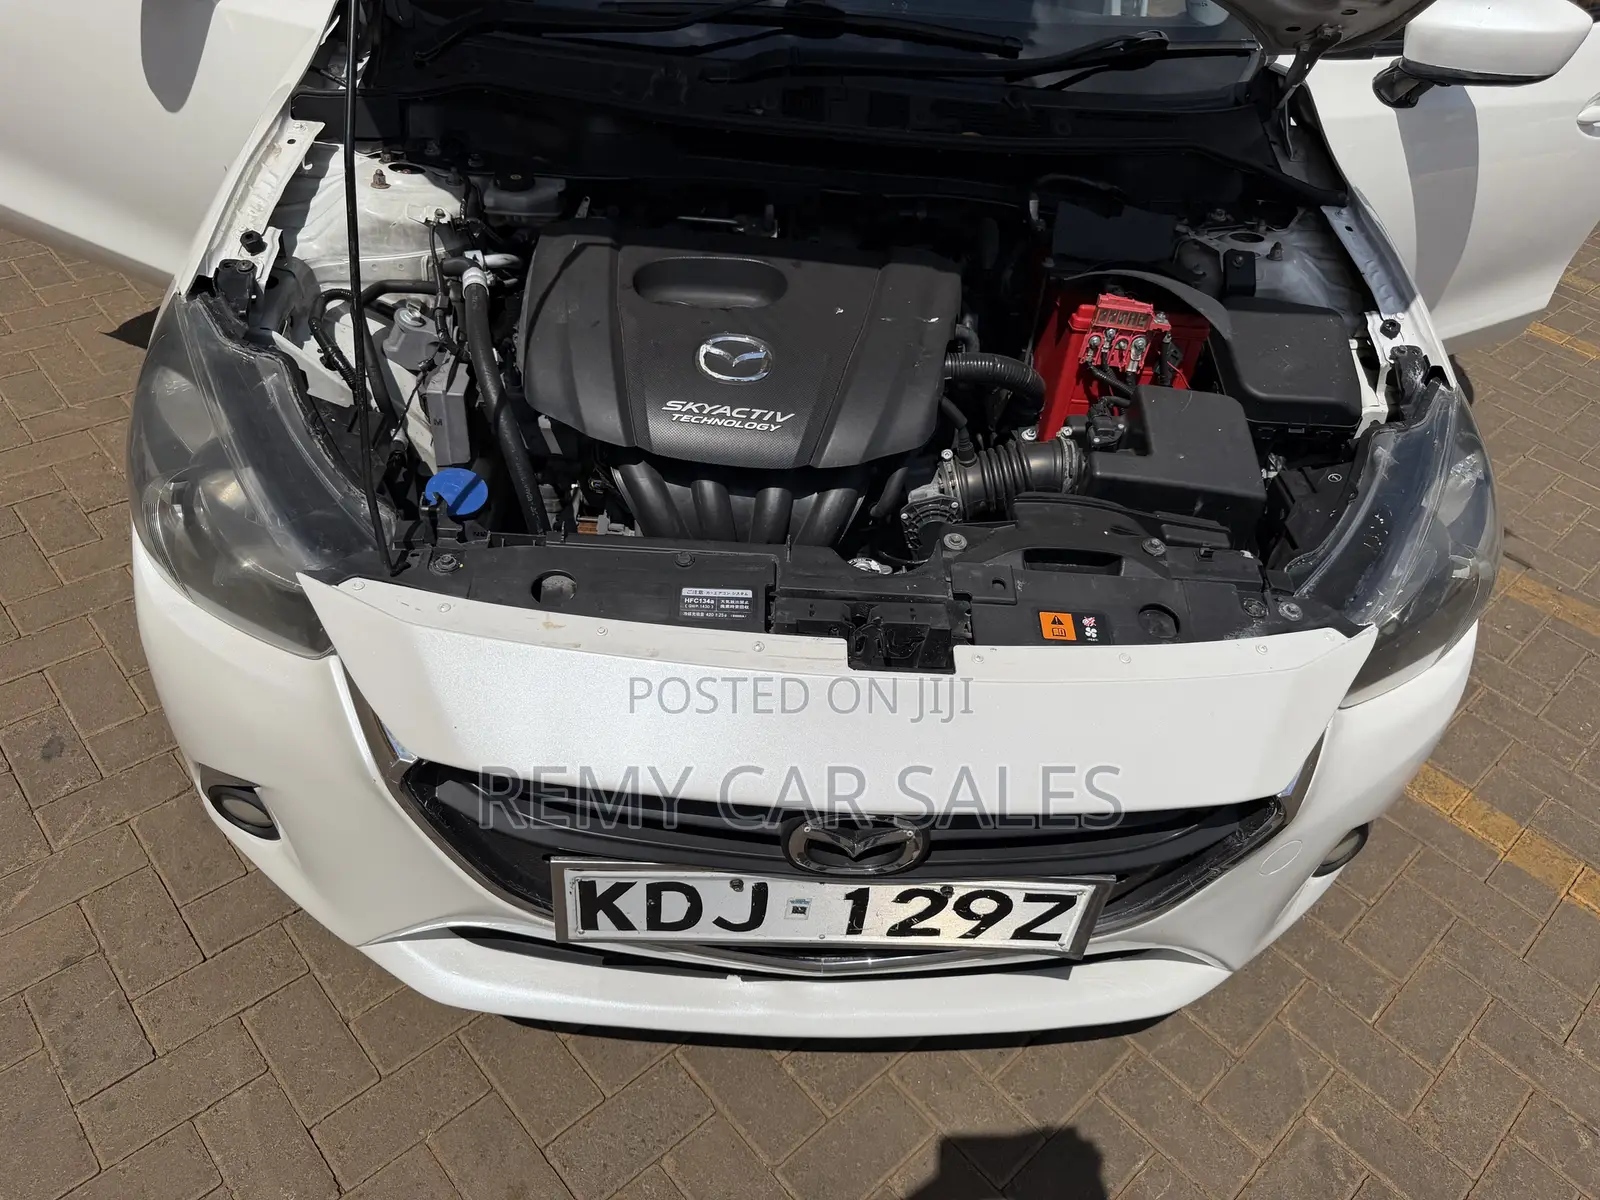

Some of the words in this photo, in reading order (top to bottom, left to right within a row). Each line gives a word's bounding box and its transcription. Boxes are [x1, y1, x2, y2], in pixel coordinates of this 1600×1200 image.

[661, 400, 795, 423] SKYACTIV
[671, 413, 782, 432] TECHNOLOGY
[576, 880, 769, 932] KDJ
[843, 886, 1078, 941] 129Z
